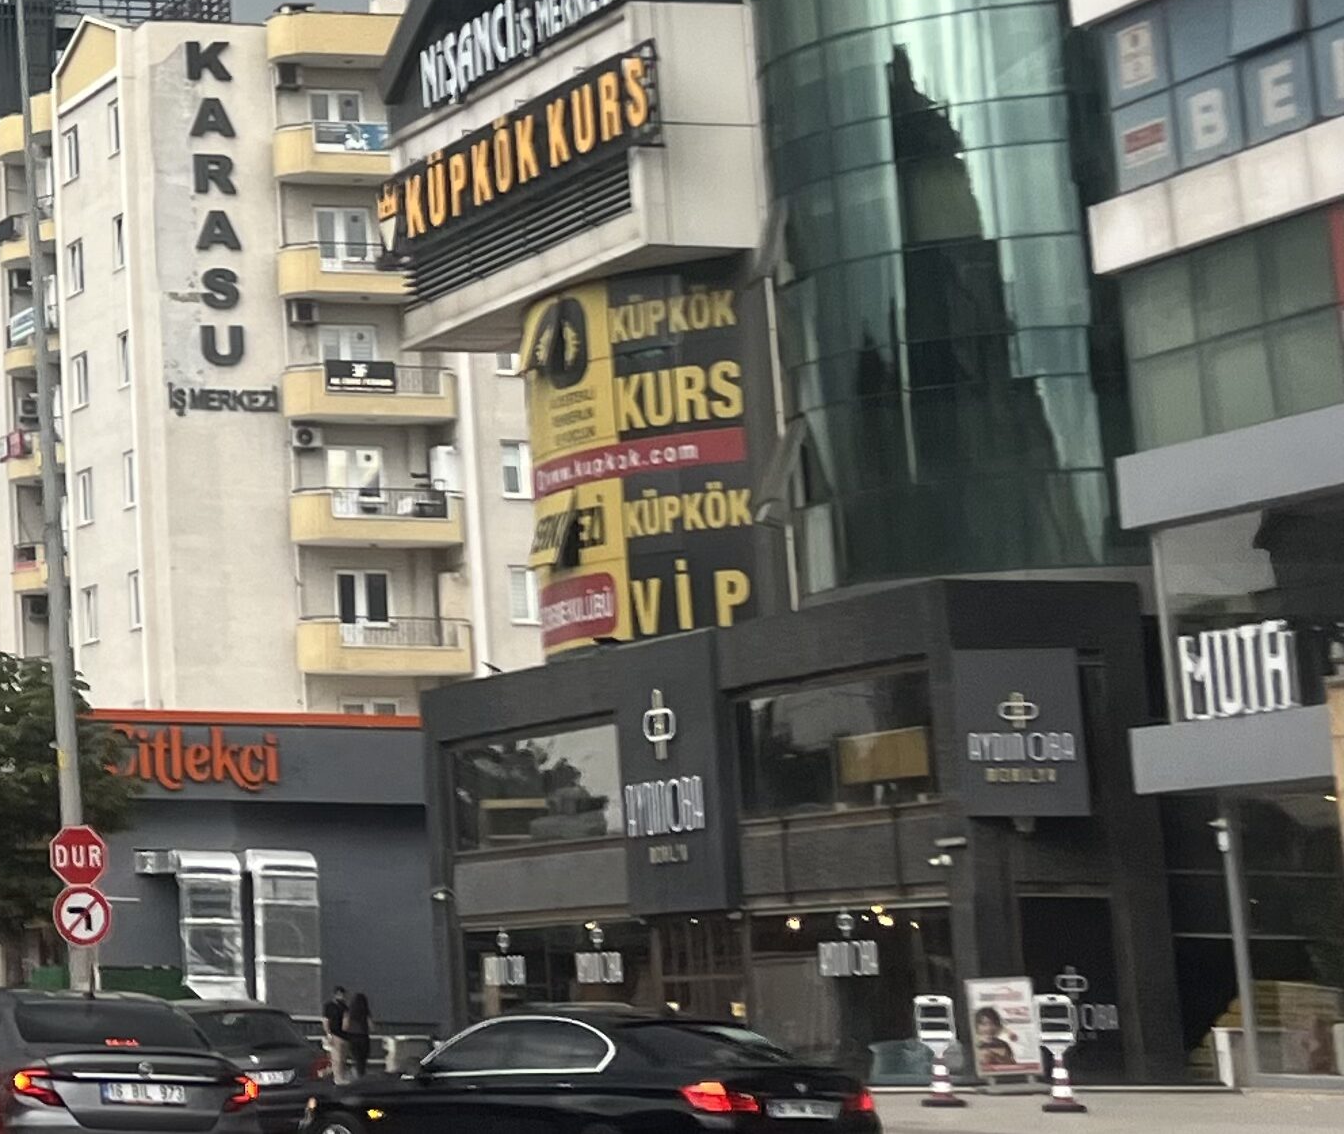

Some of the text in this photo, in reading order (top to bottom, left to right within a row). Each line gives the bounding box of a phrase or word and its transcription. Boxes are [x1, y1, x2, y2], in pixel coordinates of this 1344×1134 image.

[405, 57, 648, 239] KÜPKÖK KURS
[185, 41, 245, 367] KARASU
[609, 284, 737, 344] KÜPKÖK
[168, 382, 279, 417] İŞ MERKEZİ
[616, 360, 744, 432] KURS
[623, 481, 753, 538] KÜPKÖK
[630, 559, 751, 635] VİP
[55, 844, 102, 867] DUR
